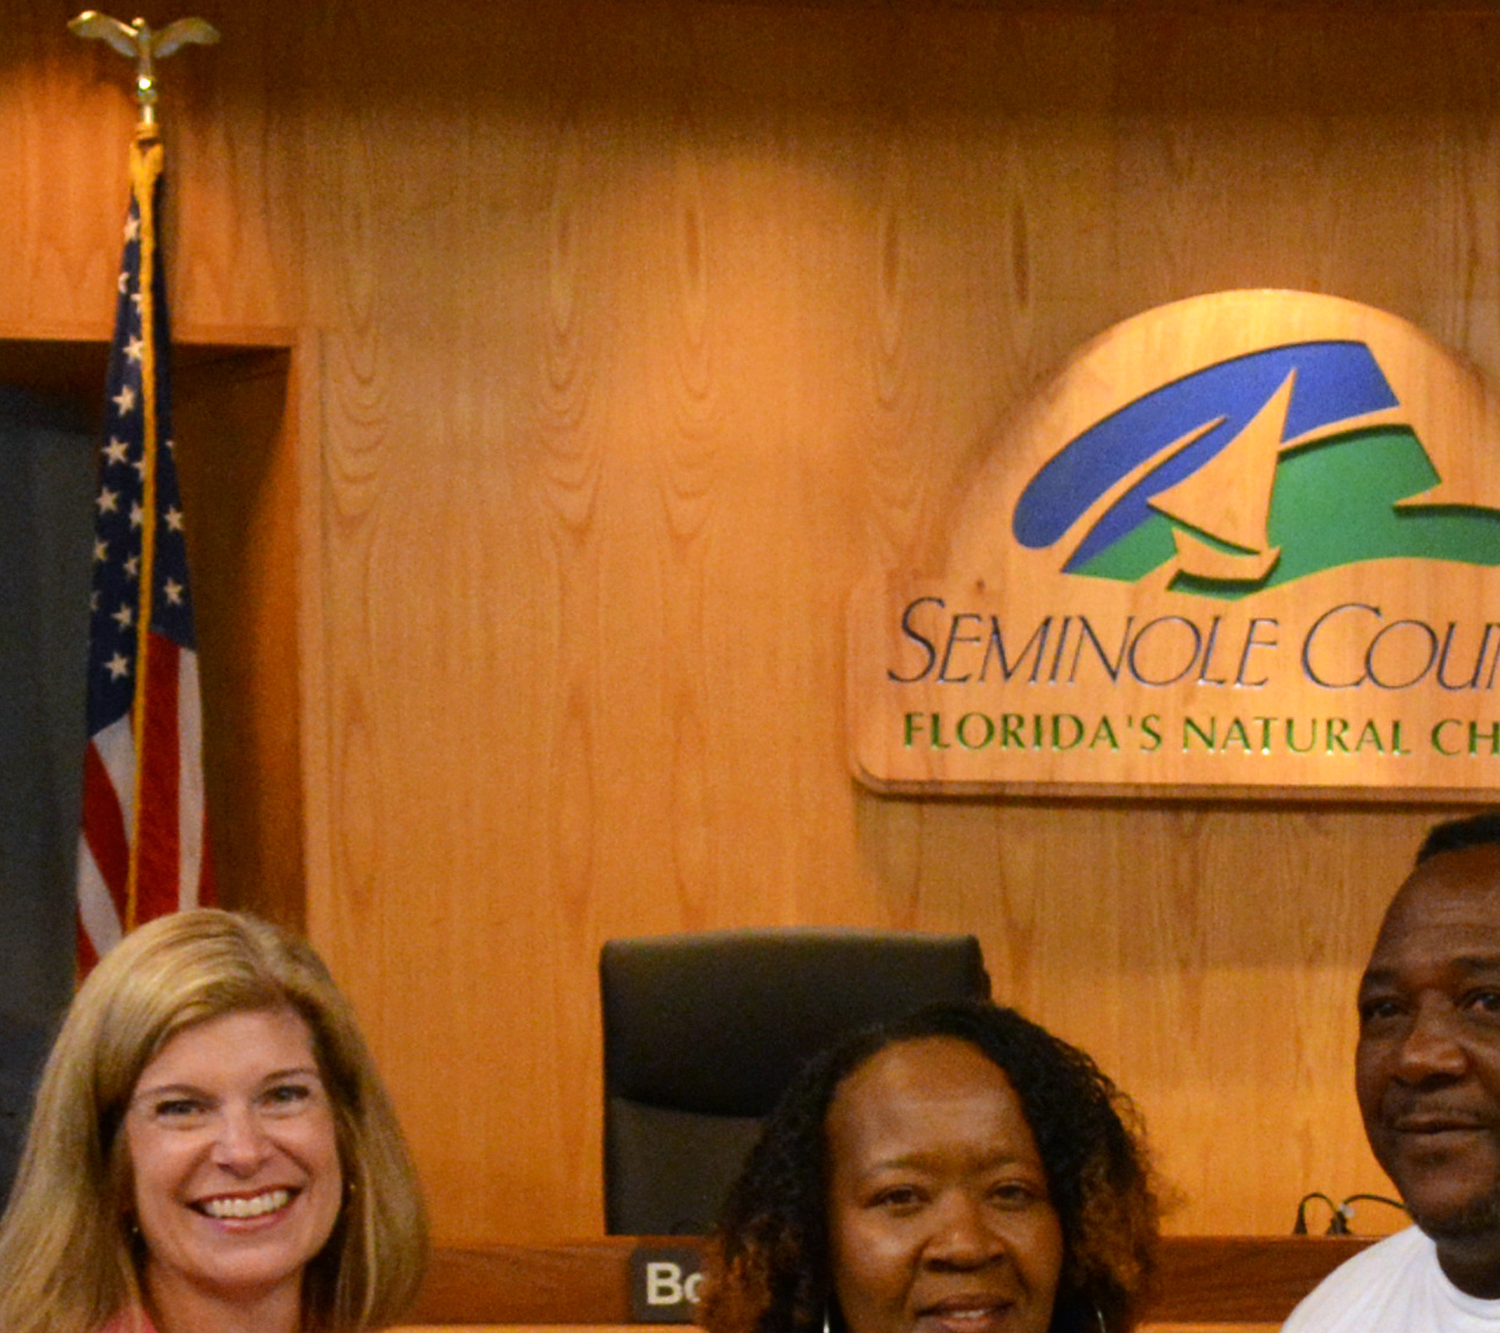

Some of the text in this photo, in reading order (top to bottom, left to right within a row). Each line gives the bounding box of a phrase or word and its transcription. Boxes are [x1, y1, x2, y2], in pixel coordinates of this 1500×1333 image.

[886, 598, 1280, 690] SEMINOLE
[901, 711, 1164, 754] FLORIDA'S
[1181, 717, 1411, 758] NATURAL
